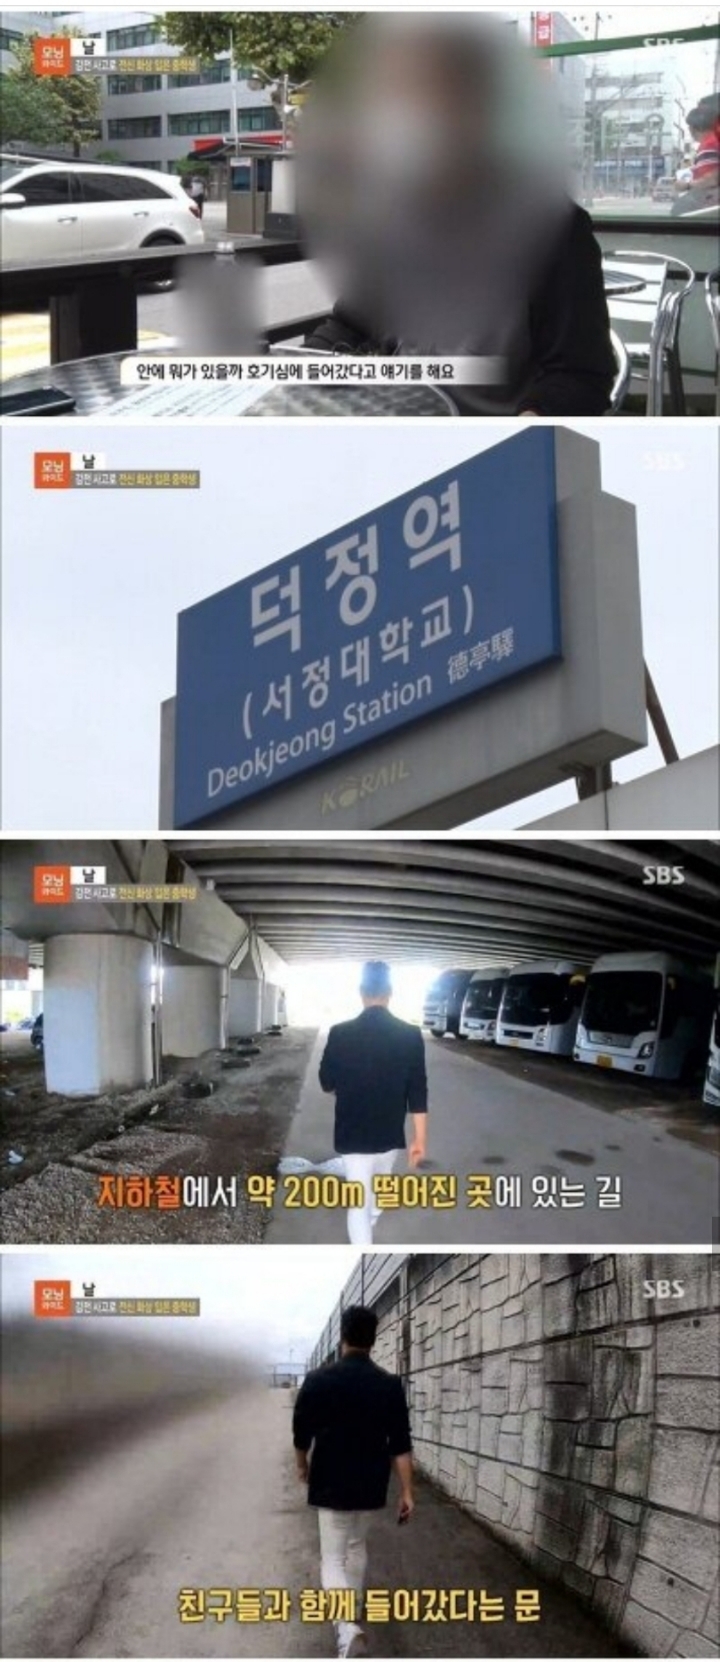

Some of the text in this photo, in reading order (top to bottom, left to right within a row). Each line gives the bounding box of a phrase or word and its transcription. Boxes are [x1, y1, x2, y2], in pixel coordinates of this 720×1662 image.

[250, 479, 461, 652] 덕정역
[241, 585, 474, 739] (서정대학교)
[447, 626, 514, 685] 德亭驛
[207, 671, 431, 798] Deokjeong Station
